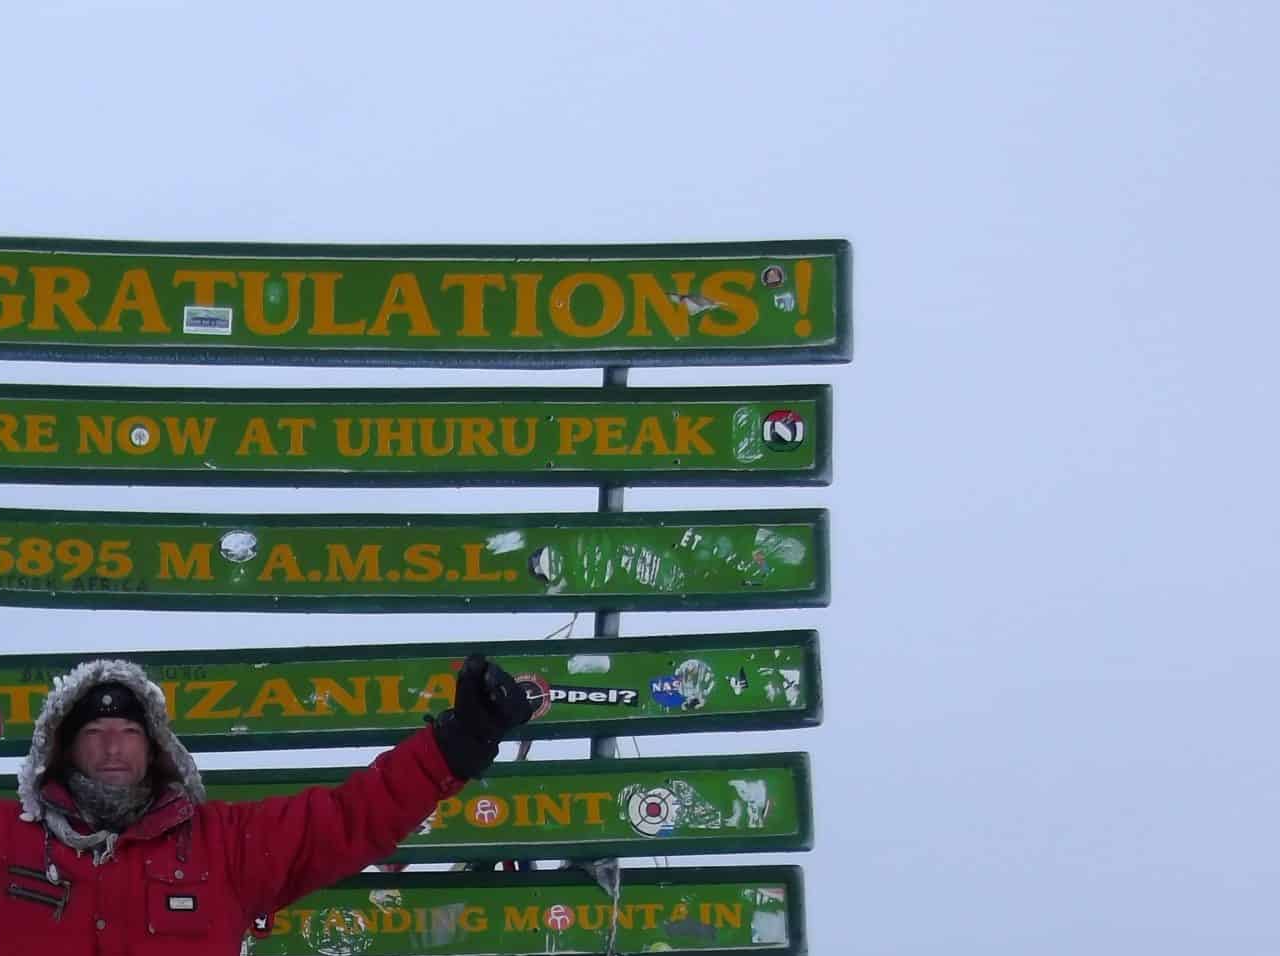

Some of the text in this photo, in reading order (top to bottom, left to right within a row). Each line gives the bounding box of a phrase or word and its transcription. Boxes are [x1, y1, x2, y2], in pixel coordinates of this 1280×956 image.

[76, 414, 218, 456] NOW
[235, 416, 317, 456] AT
[333, 416, 540, 456] UHURU
[556, 415, 717, 456] PEAK
[157, 540, 216, 580] M
[258, 543, 518, 582] A.M.S.L.
[549, 689, 638, 706] ppel?
[652, 679, 683, 692] NAS
[431, 792, 611, 829] POINT
